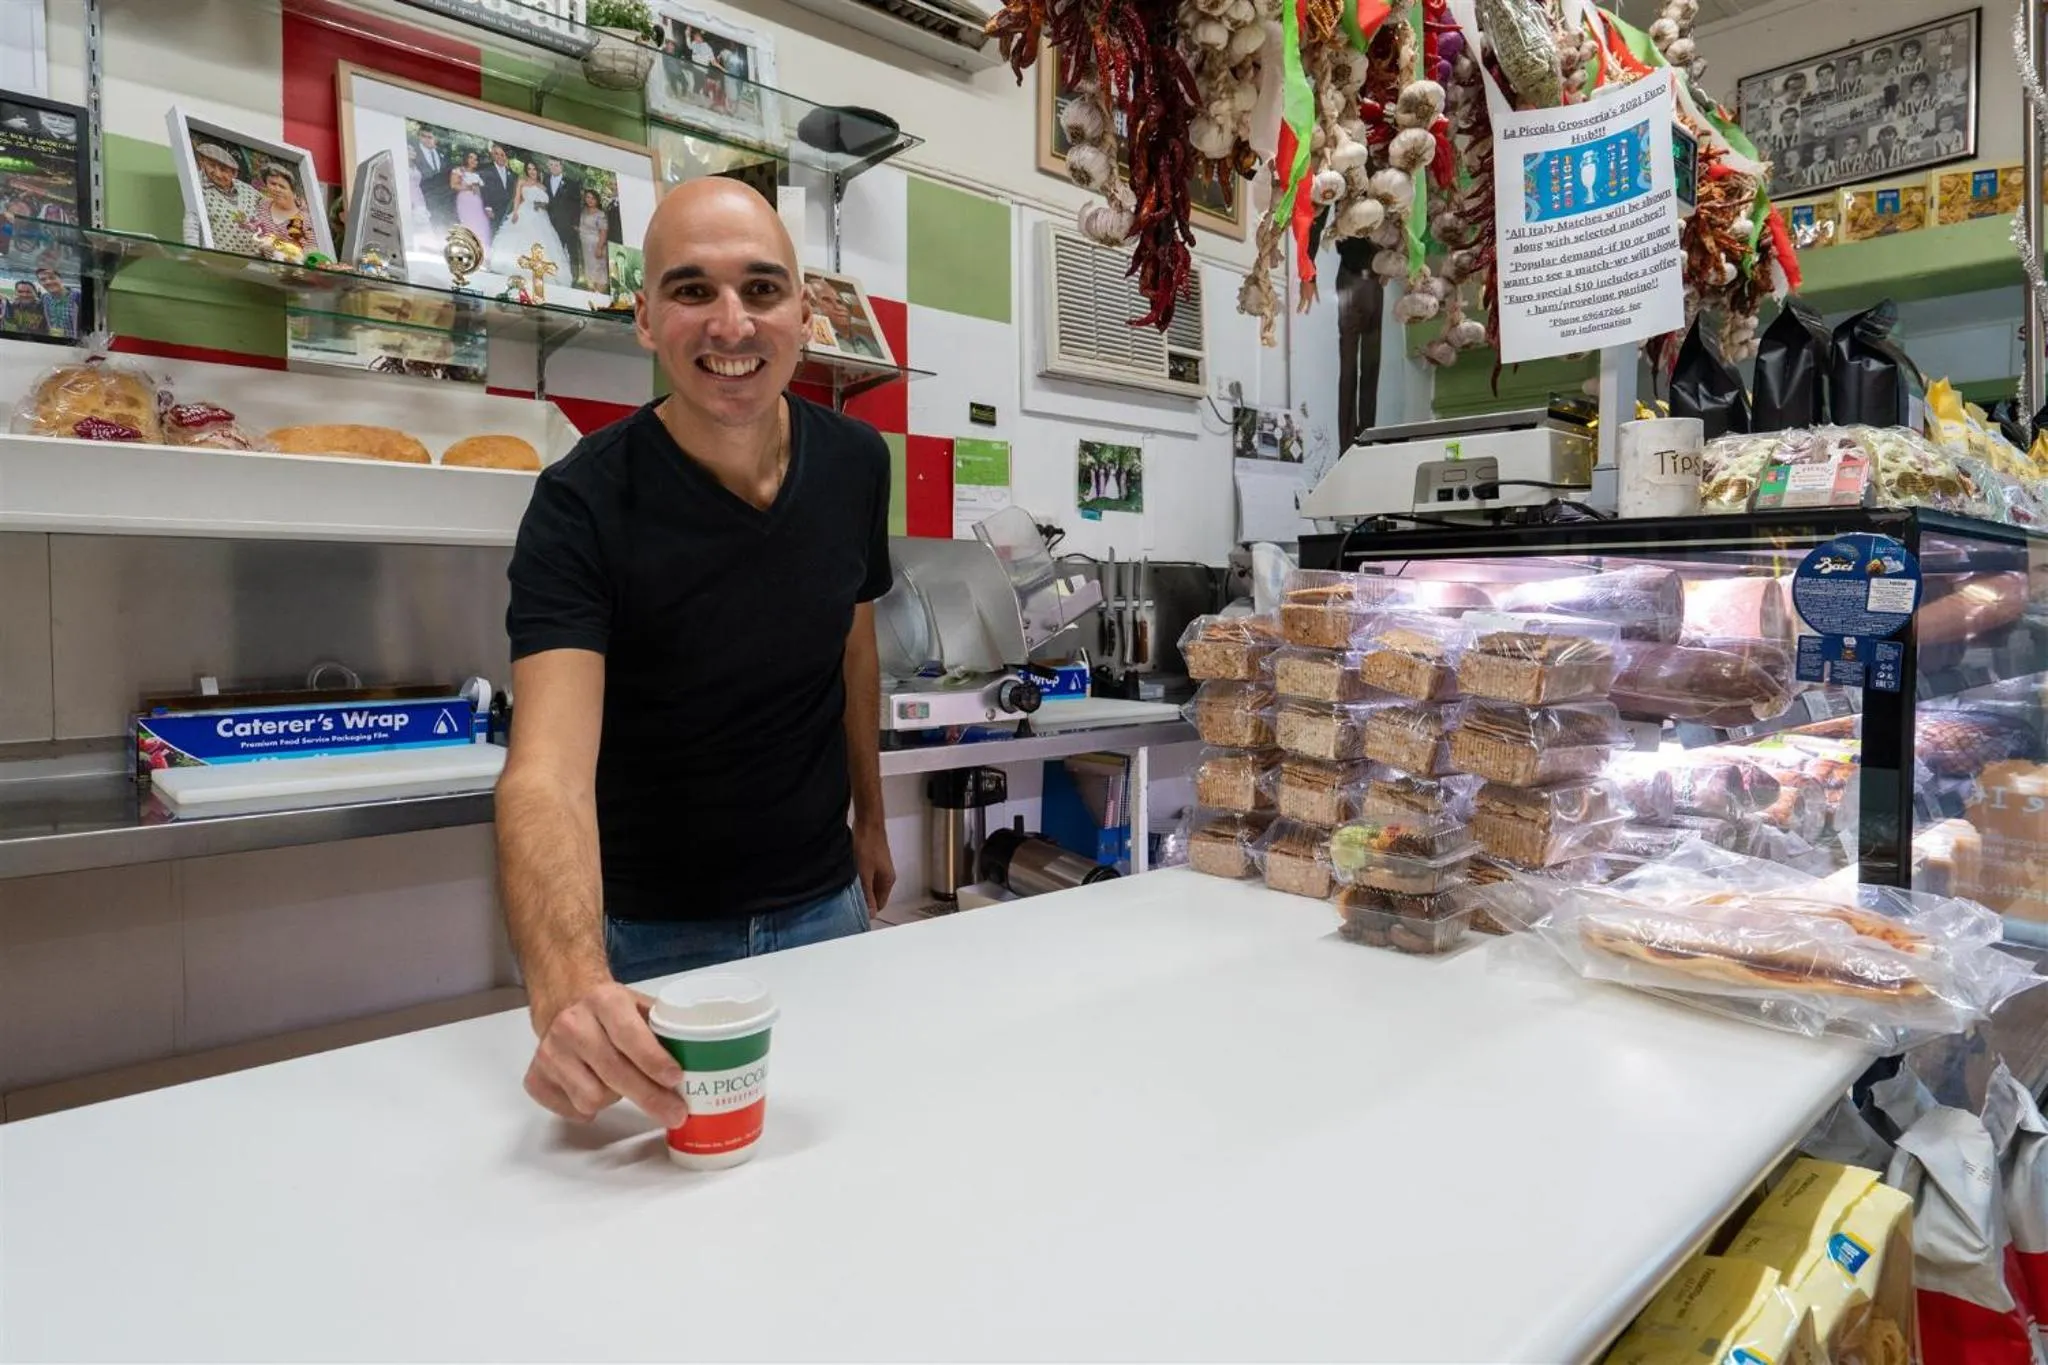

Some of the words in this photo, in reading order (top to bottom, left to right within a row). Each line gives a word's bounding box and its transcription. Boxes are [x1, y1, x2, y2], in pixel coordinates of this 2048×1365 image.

[1503, 128, 1515, 140] La
[1519, 122, 1556, 138] Piccola
[1558, 108, 1617, 132] Grosseria's
[1619, 96, 1642, 114] 2021
[1644, 83, 1667, 102] Euro
[1570, 126, 1607, 145] Hub!!!
[1528, 224, 1555, 238] Italy
[1557, 213, 1604, 231] Matches
[1606, 207, 1626, 221] will
[1628, 201, 1640, 214] be
[1641, 188, 1673, 207] shown
[1512, 240, 1544, 255] along
[1546, 235, 1571, 249] with
[1573, 224, 1617, 243] selected
[1560, 242, 1617, 264] demand-if
[1619, 239, 1632, 251] 10
[1633, 235, 1645, 246] or
[1647, 224, 1671, 242] more
[1502, 274, 1530, 289] want
[1532, 272, 1544, 284] to
[1546, 269, 1563, 282] see
[1565, 268, 1573, 278] a
[1575, 255, 1629, 275] match-we
[1631, 246, 1651, 262] will
[1536, 283, 1573, 301] special
[1575, 280, 1594, 294] $10
[1596, 271, 1640, 290] includes
[1648, 257, 1677, 276] coffee
[1629, 301, 1643, 313] for
[1560, 327, 1577, 338] any
[1579, 317, 1633, 334] information
[1653, 448, 1702, 477] Tips
[1813, 556, 1856, 575] Baci
[216, 713, 334, 737] Caterer's
[341, 709, 410, 731] Wrap
[240, 740, 278, 749] Premium
[279, 738, 300, 746] Food
[302, 736, 330, 745] Service
[331, 733, 372, 743] Packaging
[373, 731, 389, 740] Film
[685, 1080, 709, 1096] LA
